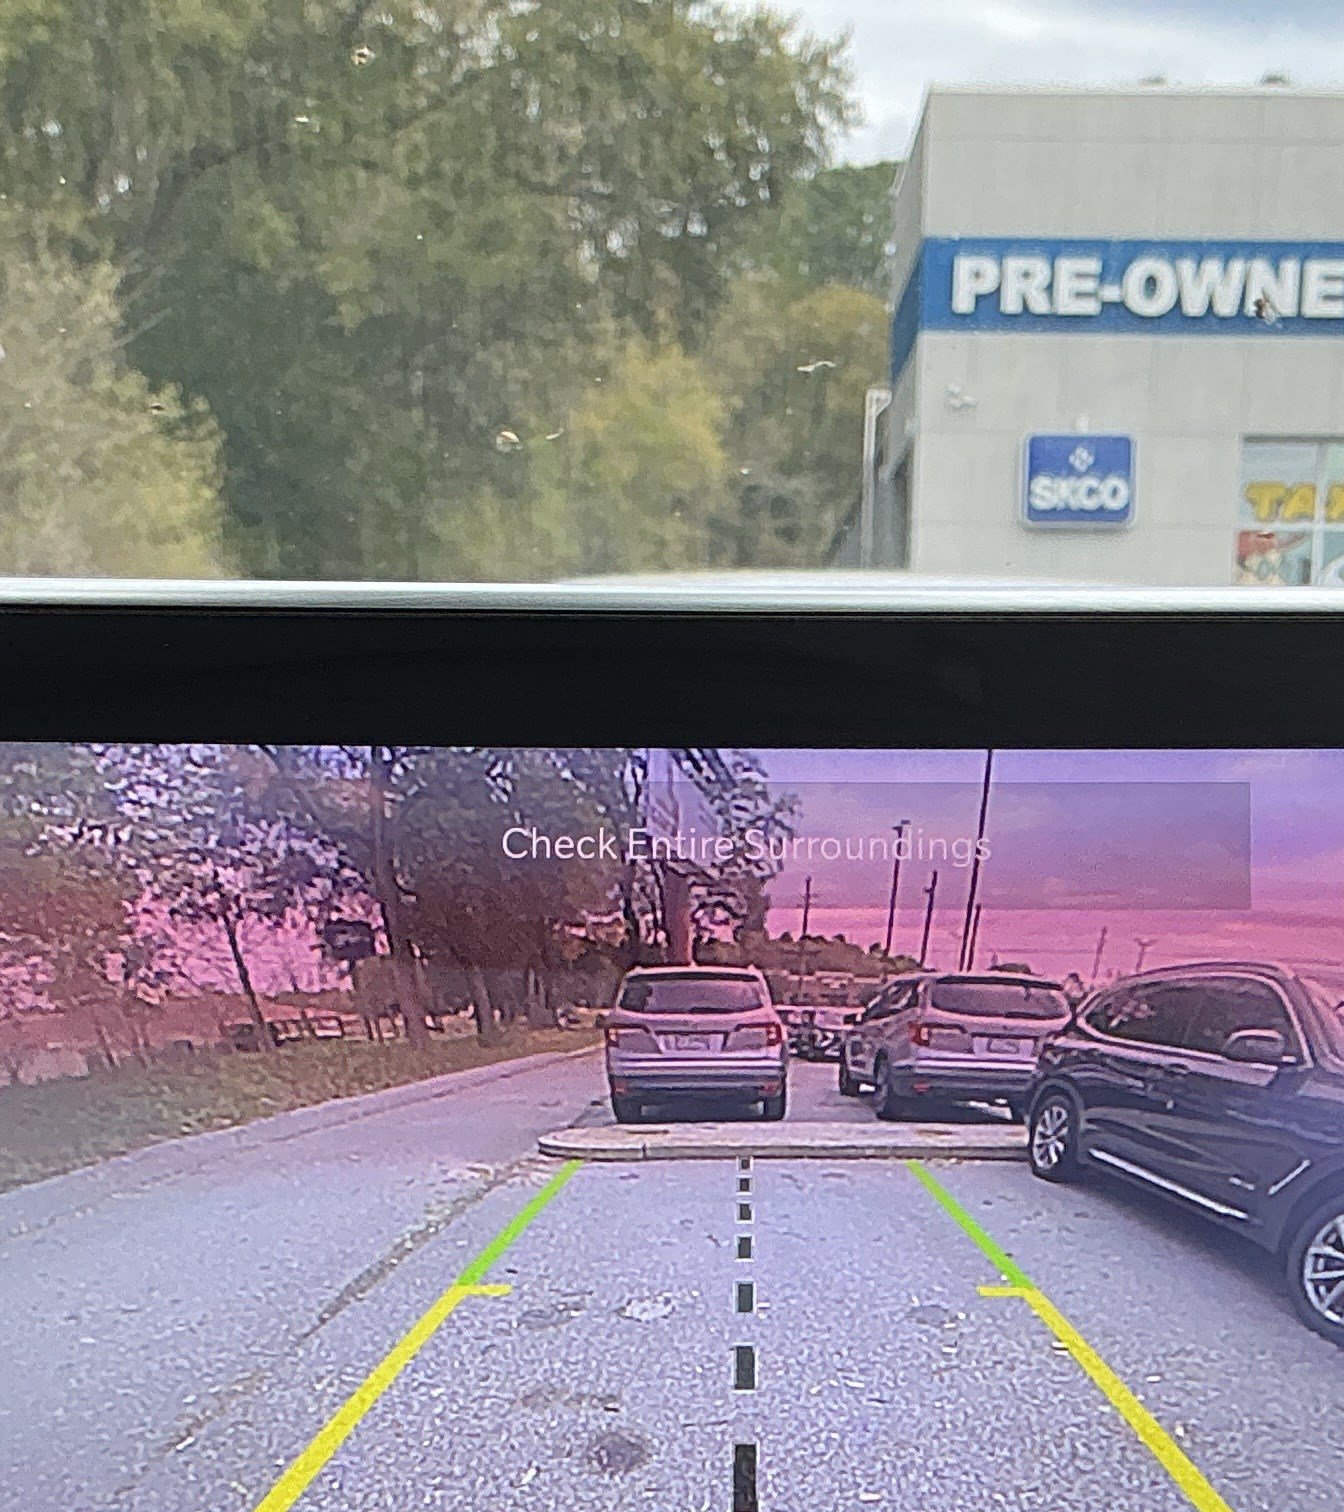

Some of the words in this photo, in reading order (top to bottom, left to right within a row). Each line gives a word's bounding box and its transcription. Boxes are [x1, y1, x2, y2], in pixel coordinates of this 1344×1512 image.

[1030, 475, 1129, 511] SKCO
[502, 826, 617, 860] Check
[628, 826, 735, 861] Entire
[744, 827, 992, 868] Surroundings
